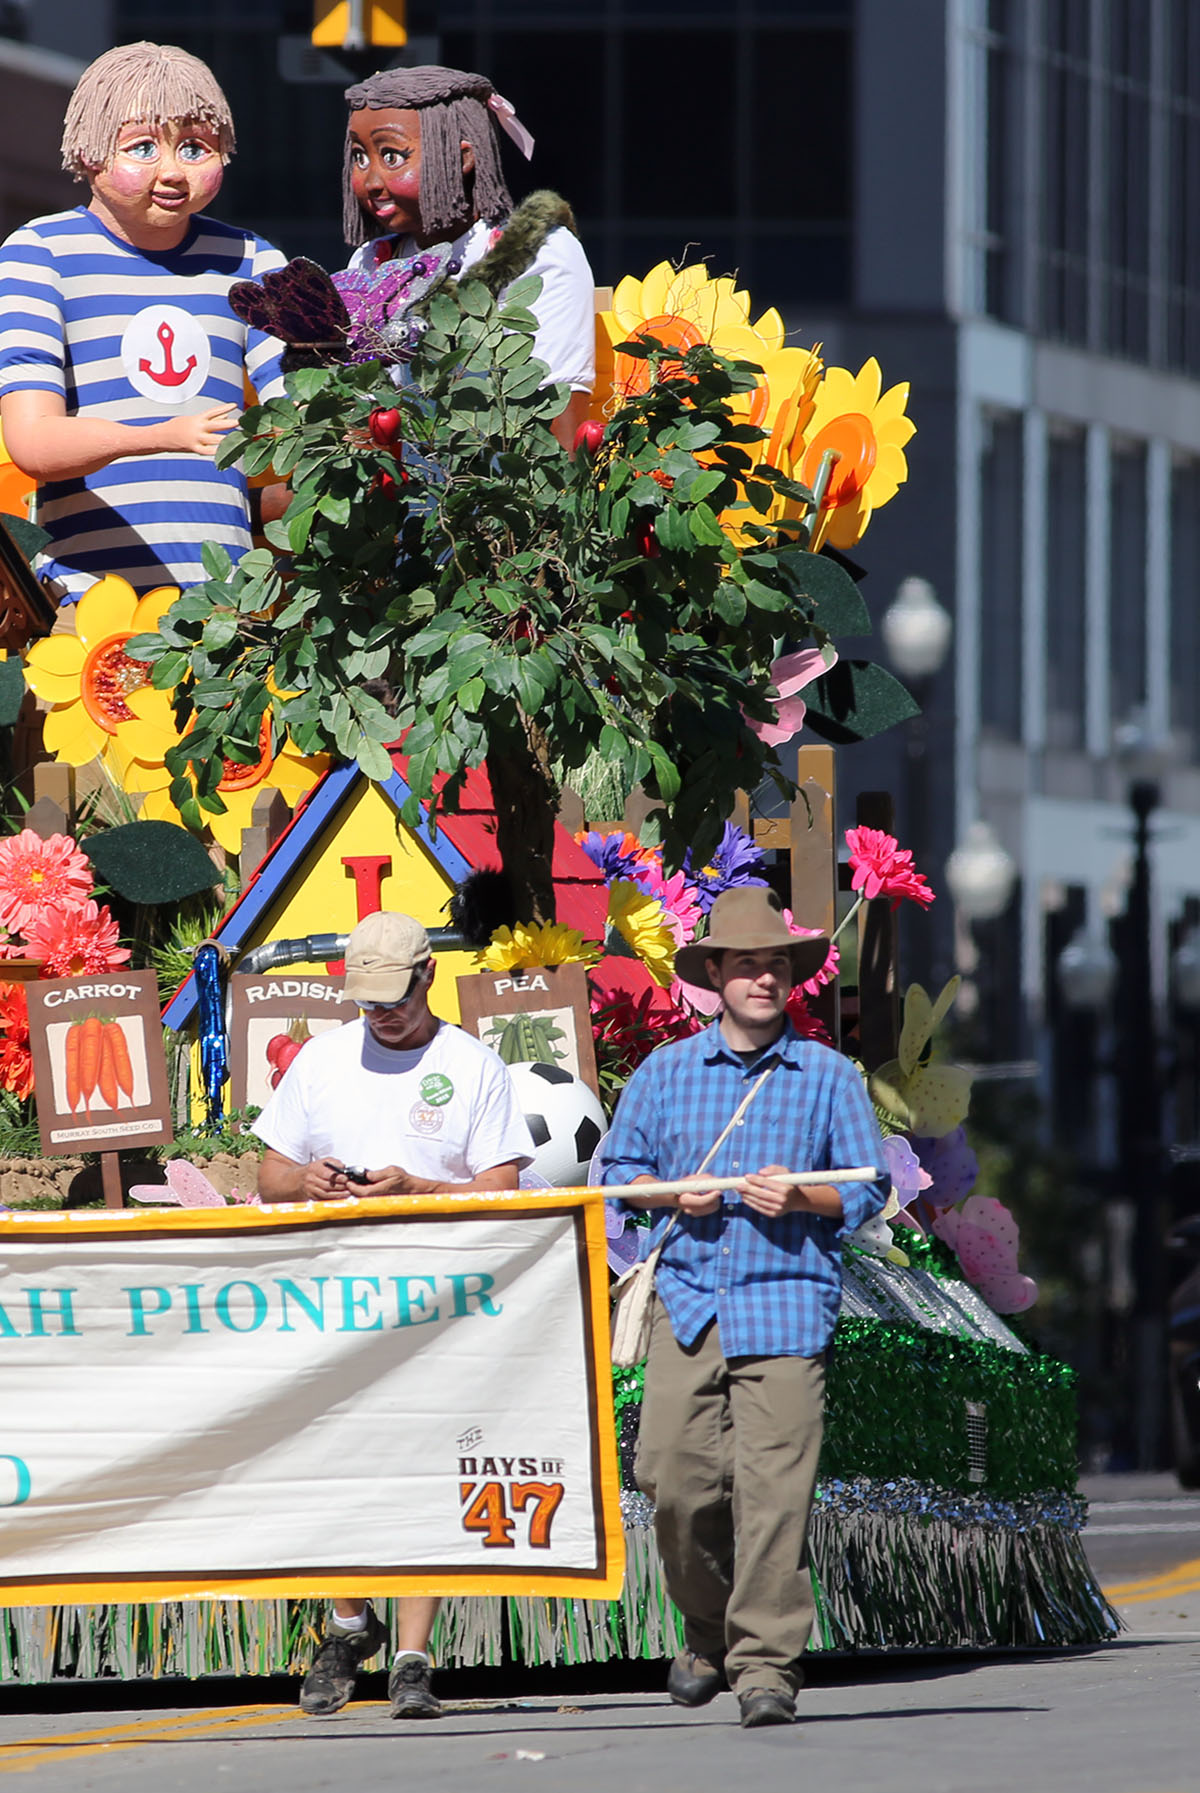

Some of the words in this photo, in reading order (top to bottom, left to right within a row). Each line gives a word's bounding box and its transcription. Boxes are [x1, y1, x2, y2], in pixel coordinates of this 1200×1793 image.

[43, 984, 142, 1007] CARROT
[245, 981, 345, 1004] RADISH
[493, 975, 550, 996] PEA
[123, 1272, 503, 1337] PIONEER
[455, 1428, 483, 1451] THE
[457, 1456, 538, 1477] DAYS
[541, 1461, 564, 1474] OF
[458, 1480, 565, 1550] '47
